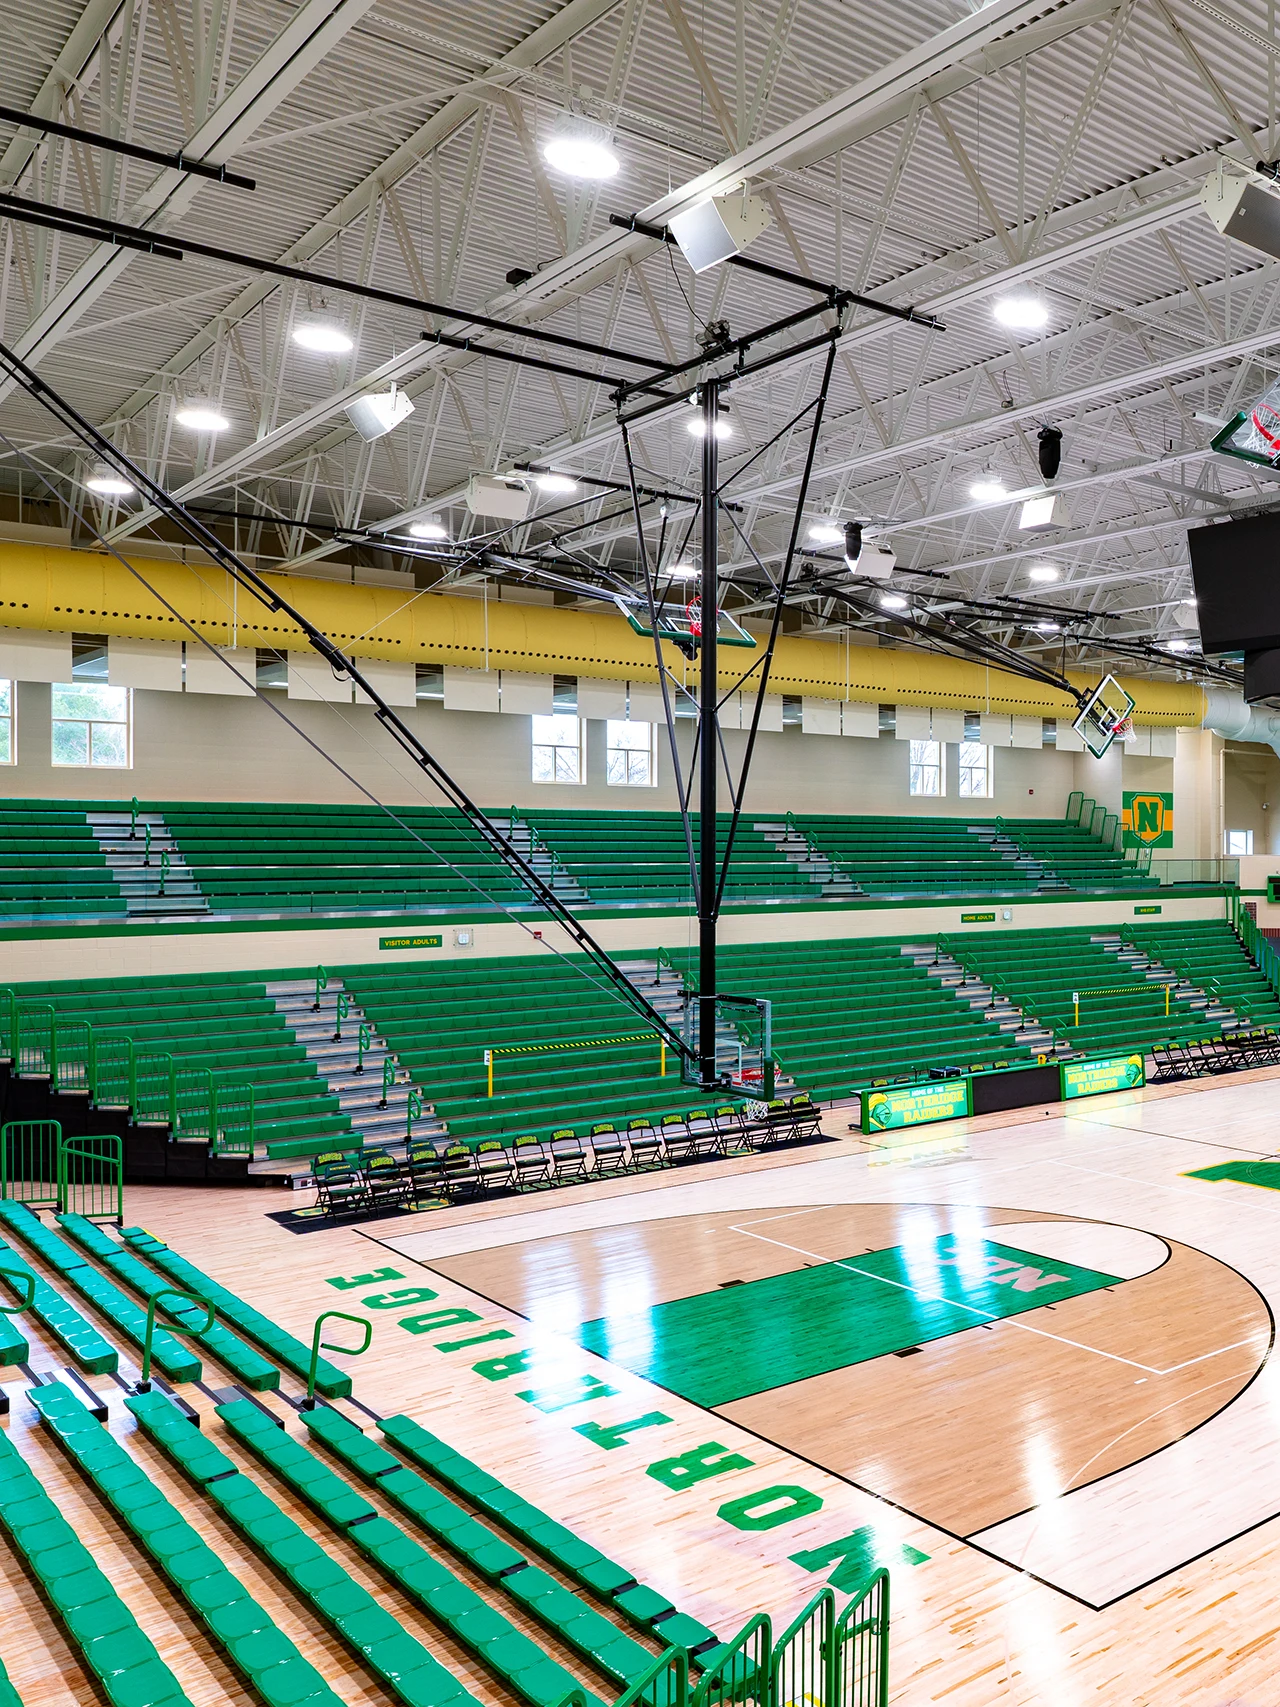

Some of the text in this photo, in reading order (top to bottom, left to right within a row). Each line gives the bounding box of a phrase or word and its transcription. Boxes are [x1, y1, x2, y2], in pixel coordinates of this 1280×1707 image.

[1137, 801, 1159, 833] N
[384, 938, 438, 947] VISITOR ADULTS
[911, 1088, 927, 1097] HOME
[1077, 1077, 1119, 1094] RAIDERS
[891, 1089, 965, 1113] NORTHRIDGE
[903, 1103, 954, 1124] RAIDERS
